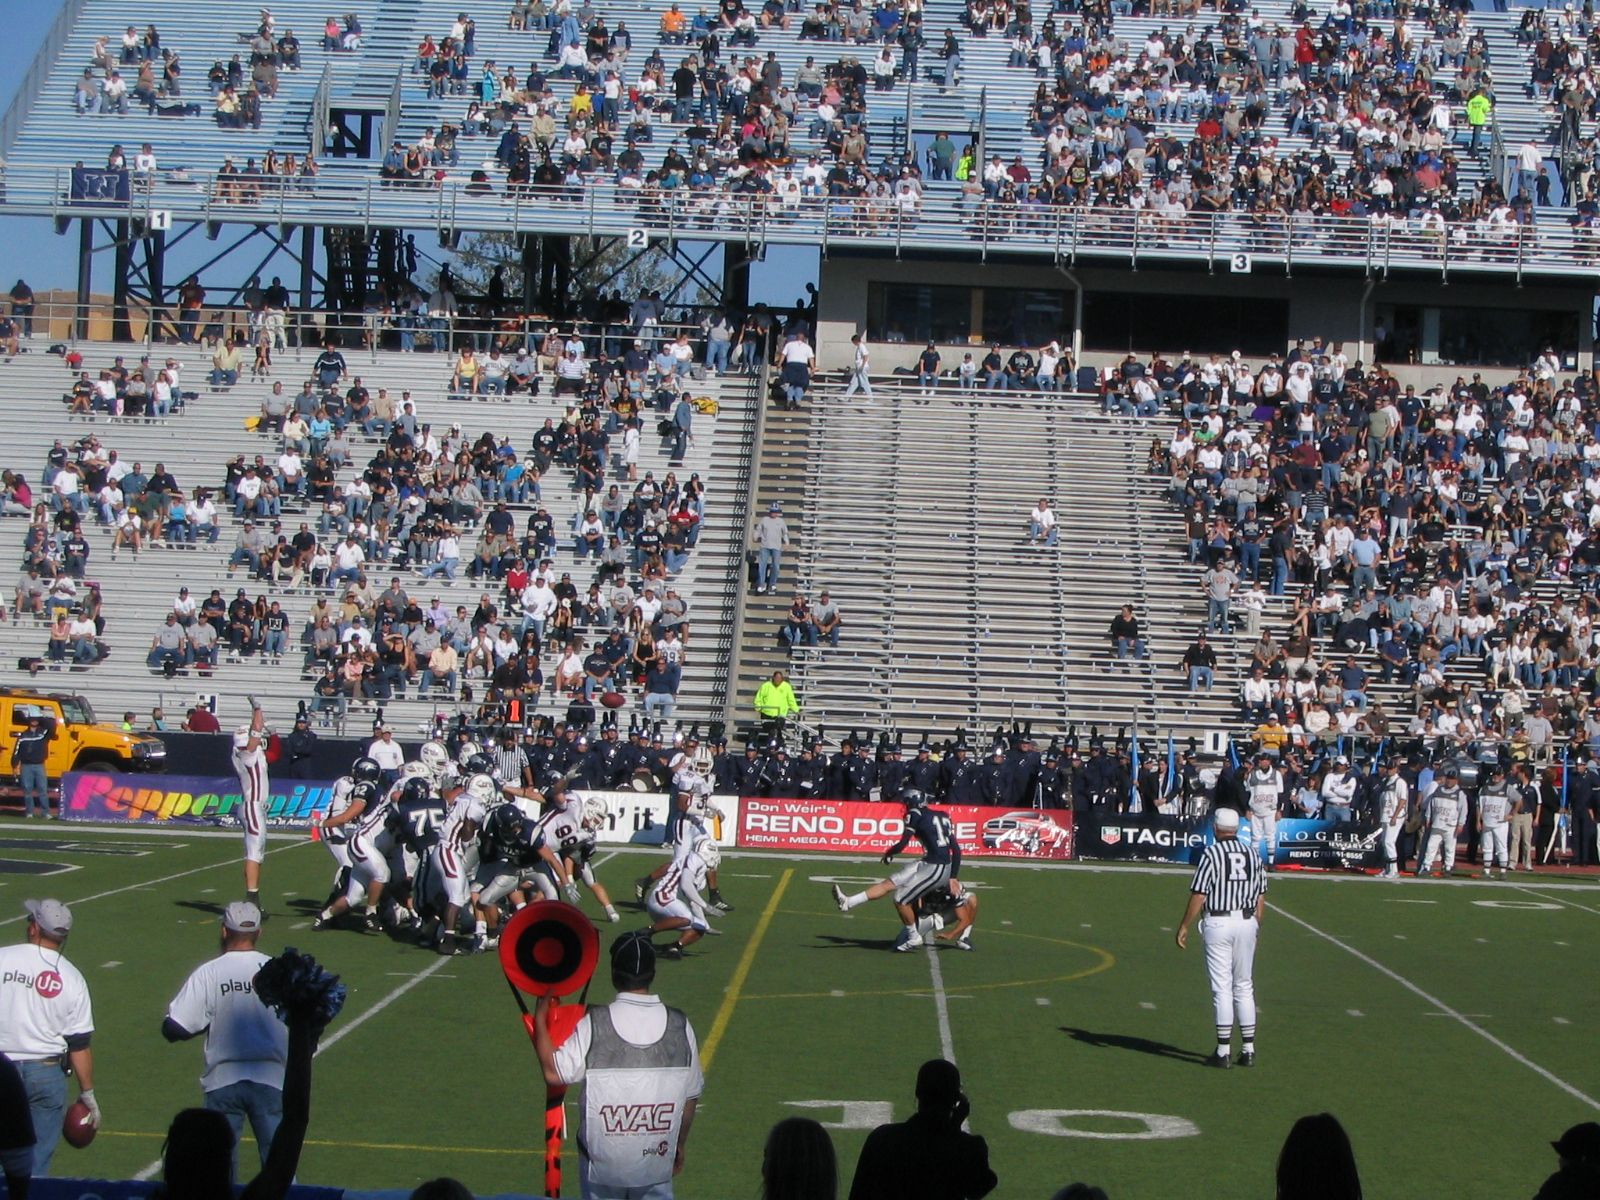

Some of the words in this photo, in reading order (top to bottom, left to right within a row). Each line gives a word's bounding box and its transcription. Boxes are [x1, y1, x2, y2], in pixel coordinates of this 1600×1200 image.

[157, 212, 165, 227] 1
[632, 230, 644, 245] 2
[1235, 254, 1247, 270] 3
[748, 802, 779, 812] Don
[784, 803, 836, 814] Weir's
[409, 808, 444, 836] 75
[633, 807, 653, 831] it
[746, 814, 844, 834] RENO
[853, 818, 977, 839] DOE
[746, 834, 778, 842] HEMI
[789, 836, 828, 845] MEGA
[831, 837, 859, 846] CAB
[1289, 850, 1311, 859] RENO
[1228, 852, 1247, 880] R
[600, 1103, 675, 1132] WAC
